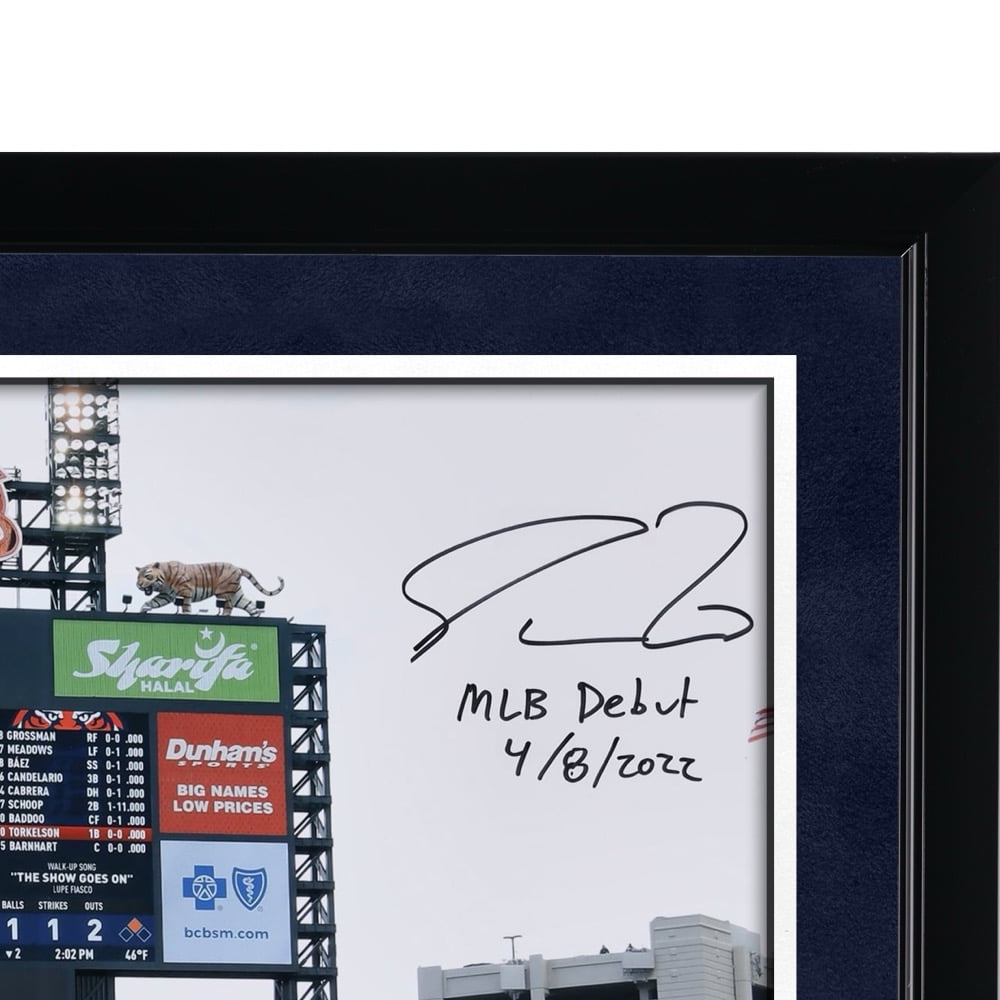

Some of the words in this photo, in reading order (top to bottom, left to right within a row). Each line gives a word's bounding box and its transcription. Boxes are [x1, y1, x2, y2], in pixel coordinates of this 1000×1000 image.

[73, 638, 254, 692] Sharifa
[141, 680, 194, 694] HALAL
[457, 682, 548, 721] MLB
[577, 676, 699, 723] Debut
[6, 731, 56, 742] GROSSMAN
[8, 744, 53, 755] MEADOWS
[166, 733, 278, 763] Dunham's
[505, 732, 702, 788] 4/8/2022
[8, 772, 63, 782] CANDELARIO
[8, 786, 50, 796] CABRERA
[177, 784, 206, 797] BIG
[211, 785, 268, 798] NAMES
[8, 800, 44, 810] SCHOOP
[173, 801, 209, 814] LOW
[214, 802, 274, 814] PRICES
[8, 814, 44, 824] BADDOO
[8, 828, 60, 838] TORKELSON
[9, 842, 58, 852] BARNHART
[48, 863, 78, 871] WALK-UP
[79, 863, 96, 872] SONG
[42, 872, 76, 884] SHOW
[80, 874, 109, 884] GOES
[53, 885, 70, 894] LUPE
[70, 886, 93, 894] FIASCO
[2, 900, 24, 910] BALLS
[38, 901, 68, 910] STRIKES
[84, 902, 104, 911] OUTS
[184, 927, 269, 940] bcbsm.com
[55, 948, 76, 960] 2:02
[79, 950, 94, 960] PM
[125, 949, 148, 960] 46°F
